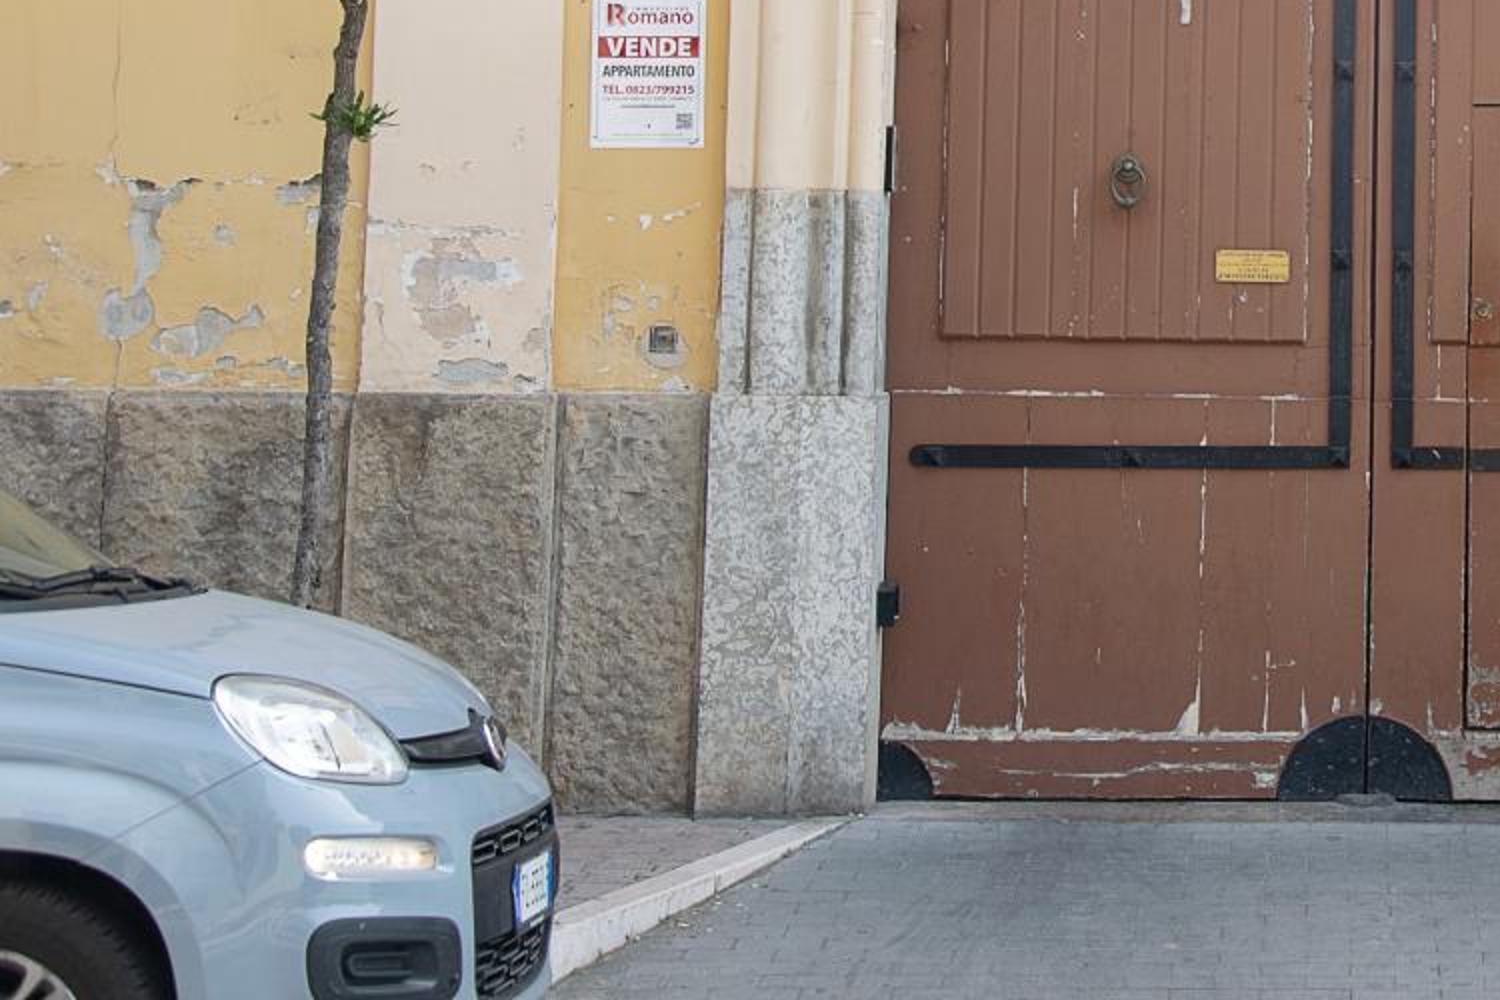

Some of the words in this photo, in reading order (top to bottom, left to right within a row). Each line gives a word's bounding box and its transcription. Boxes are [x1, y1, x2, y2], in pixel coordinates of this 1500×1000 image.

[607, 3, 694, 25] Romano
[607, 37, 692, 57] VENDE
[602, 65, 695, 77] APPARTAMENTO
